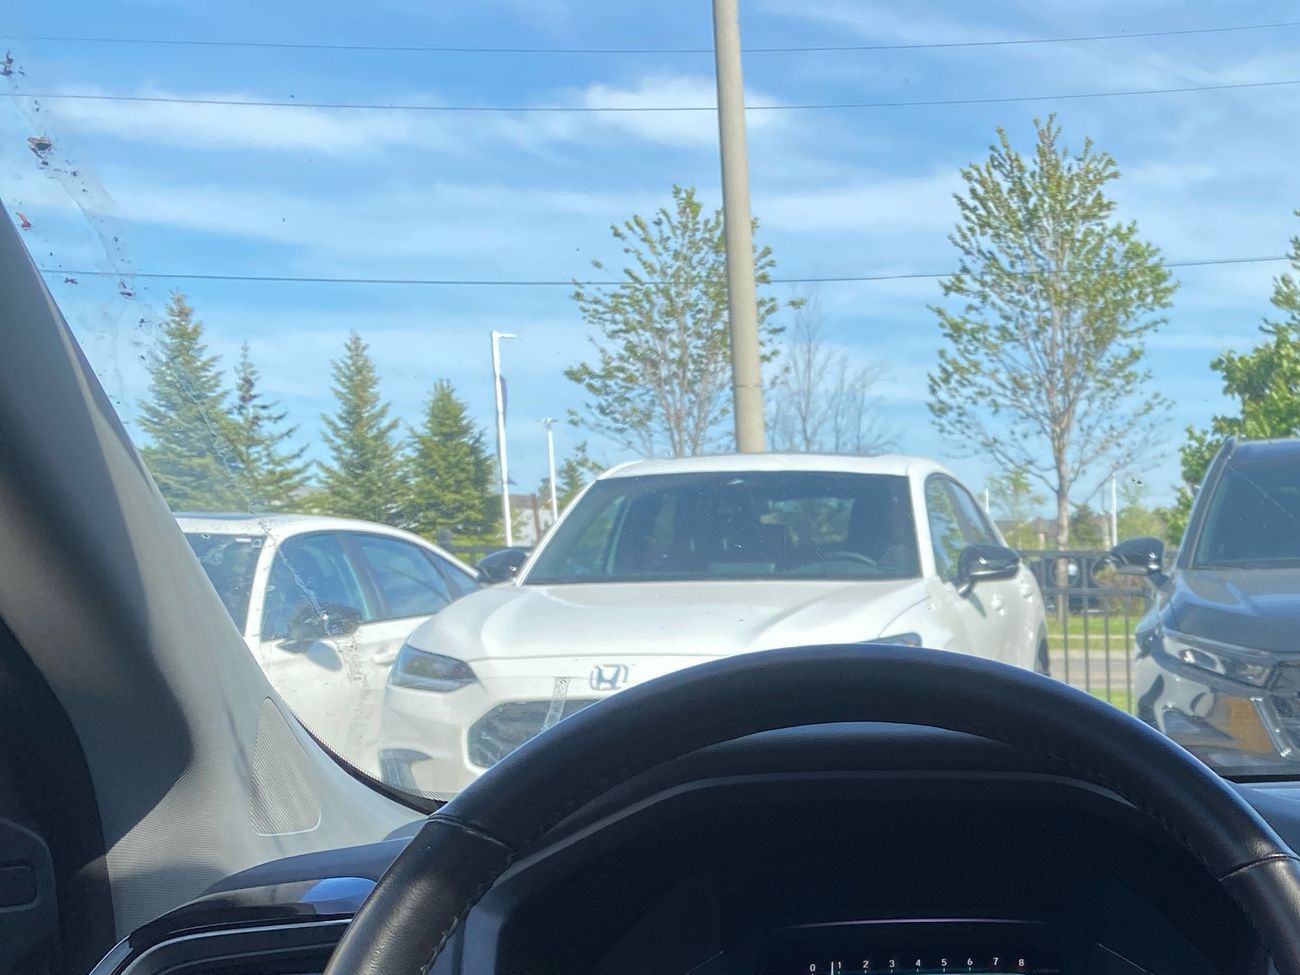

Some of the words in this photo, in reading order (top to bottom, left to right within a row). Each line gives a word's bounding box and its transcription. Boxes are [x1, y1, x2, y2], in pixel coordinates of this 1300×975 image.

[809, 963, 816, 972] 0
[863, 960, 869, 968] 2
[889, 959, 895, 968] 3
[915, 959, 921, 967] 4
[941, 958, 947, 967] 5
[967, 958, 973, 966] 6
[993, 957, 999, 966] 7
[1018, 959, 1025, 967] 8
